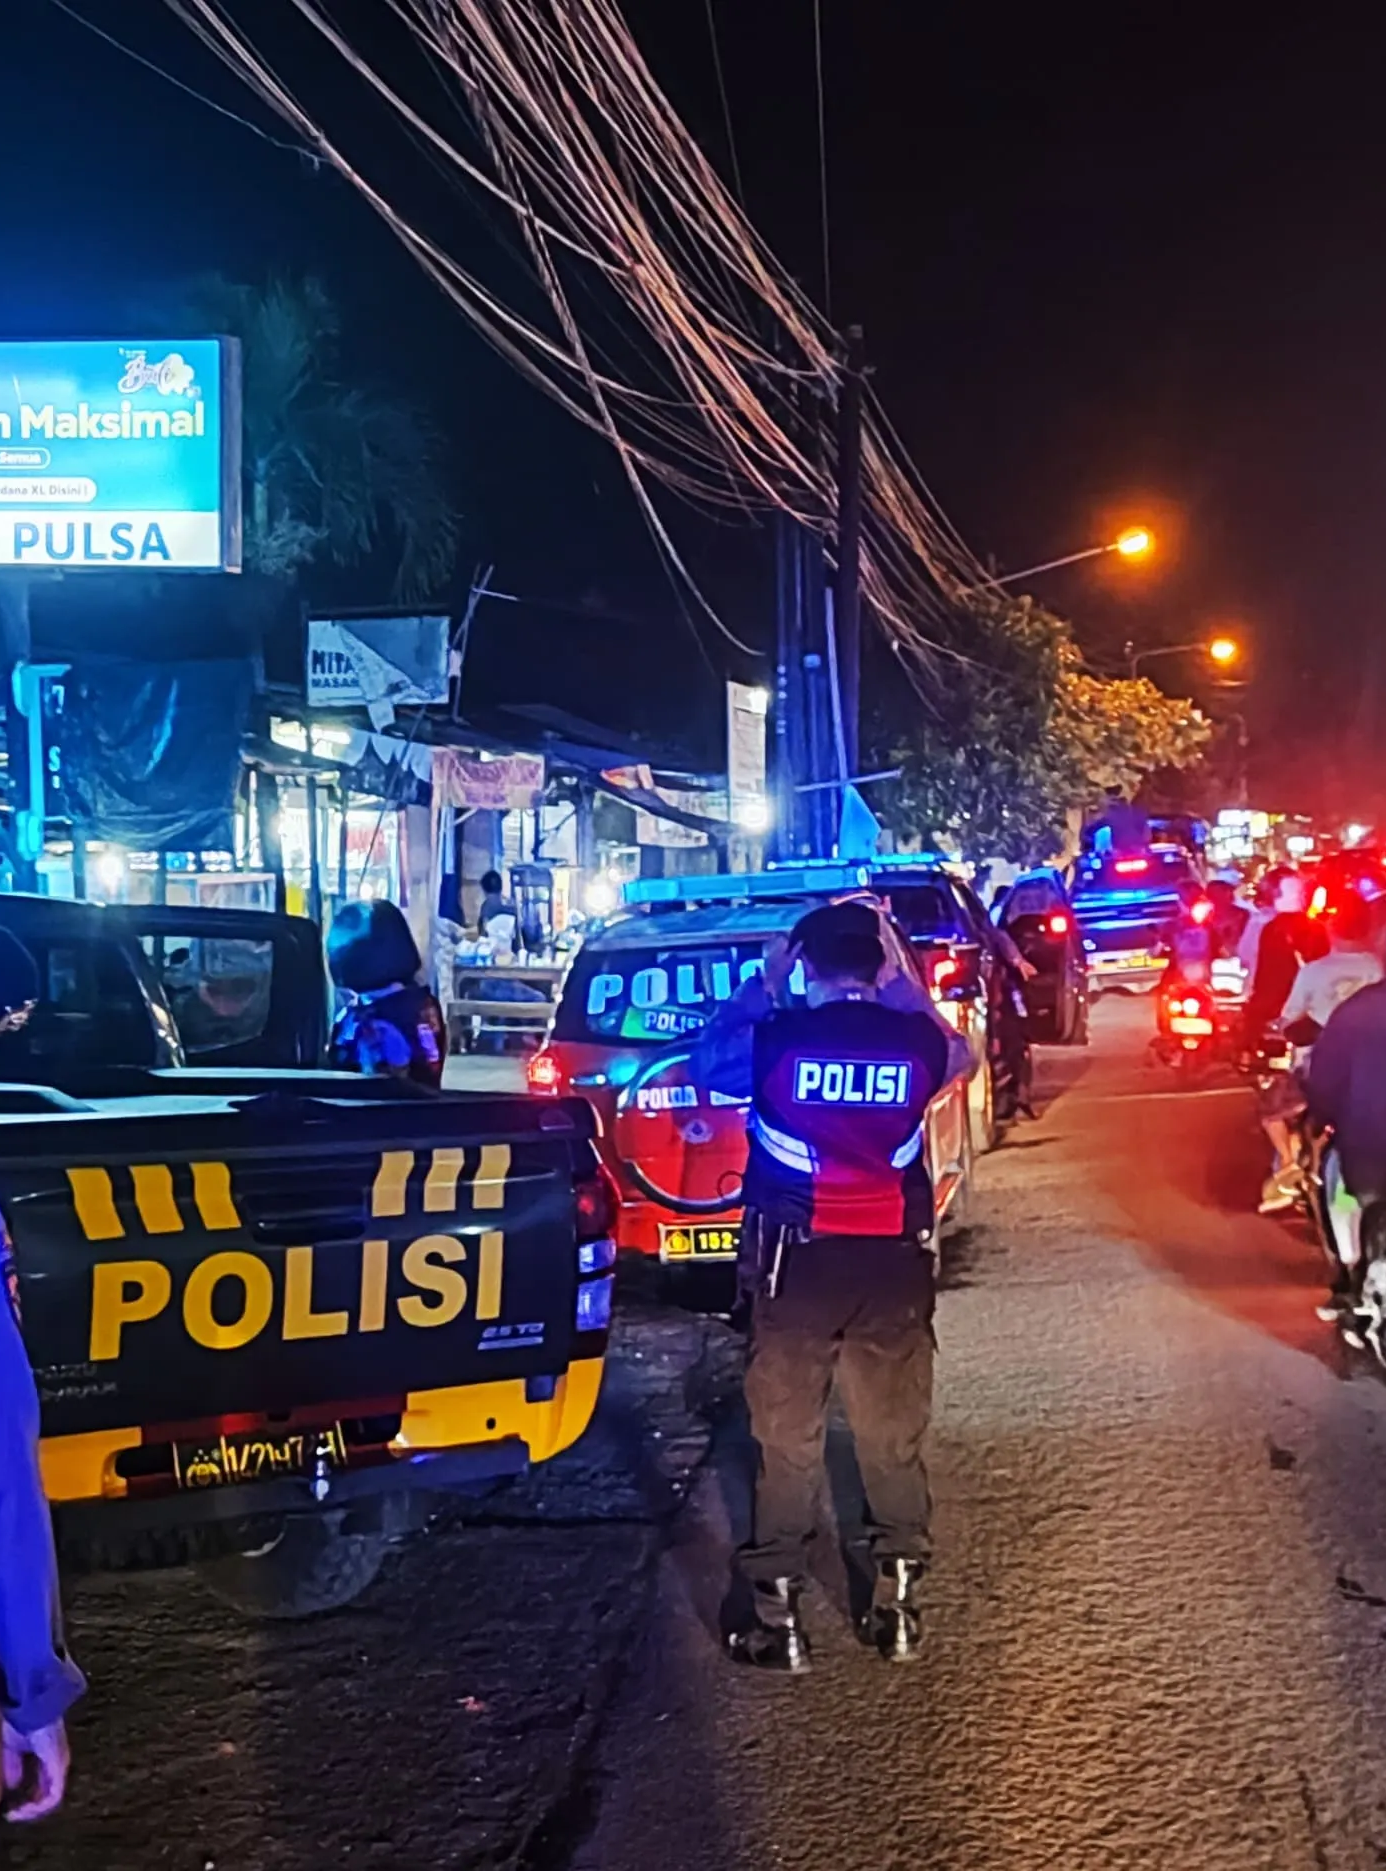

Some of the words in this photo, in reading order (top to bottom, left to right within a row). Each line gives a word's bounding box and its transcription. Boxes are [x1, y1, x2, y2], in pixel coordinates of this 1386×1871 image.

[20, 401, 204, 438] Maksimal
[31, 485, 45, 496] XL
[49, 484, 81, 496] Disini
[14, 521, 171, 561] PULSA
[796, 1061, 908, 1104] POLISI
[89, 1231, 504, 1361] POLISI
